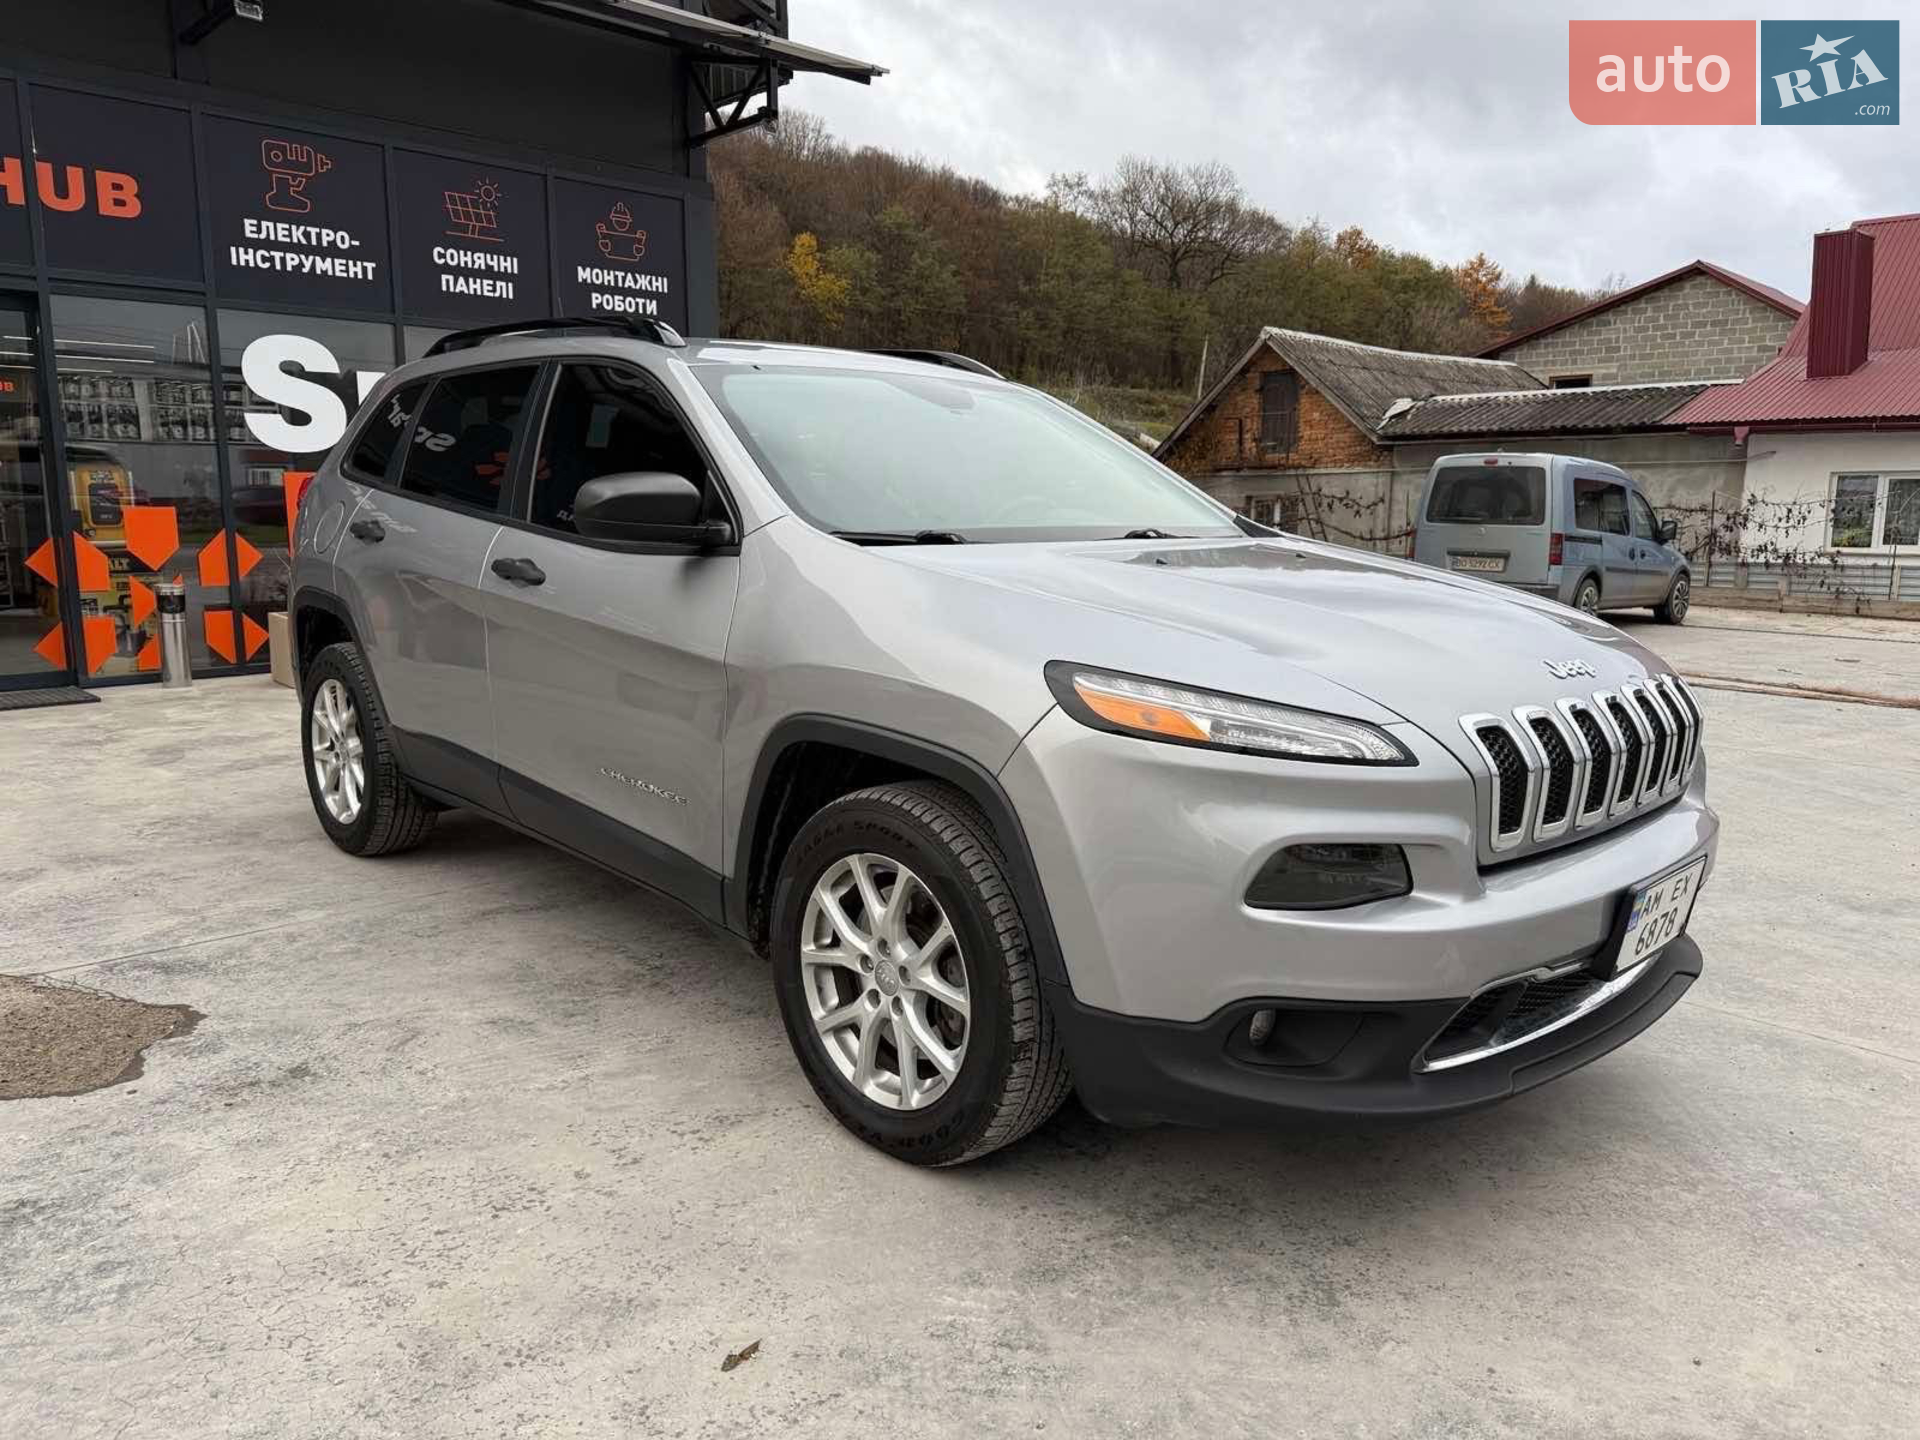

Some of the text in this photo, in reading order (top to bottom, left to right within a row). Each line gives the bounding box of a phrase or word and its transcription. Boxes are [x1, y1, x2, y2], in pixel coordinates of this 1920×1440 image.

[243, 218, 360, 250] ЕЛЕКТРО-
[230, 246, 376, 281] ІНСТРУМЕНТ
[432, 246, 519, 275] СОНЯЧНІ
[441, 274, 514, 300] ПАНЕЛІ
[577, 265, 669, 294] МОНТАЖНІ
[591, 292, 658, 316] РОБОТИ
[1641, 873, 1693, 918] AM EX
[1635, 906, 1679, 956] 6878
